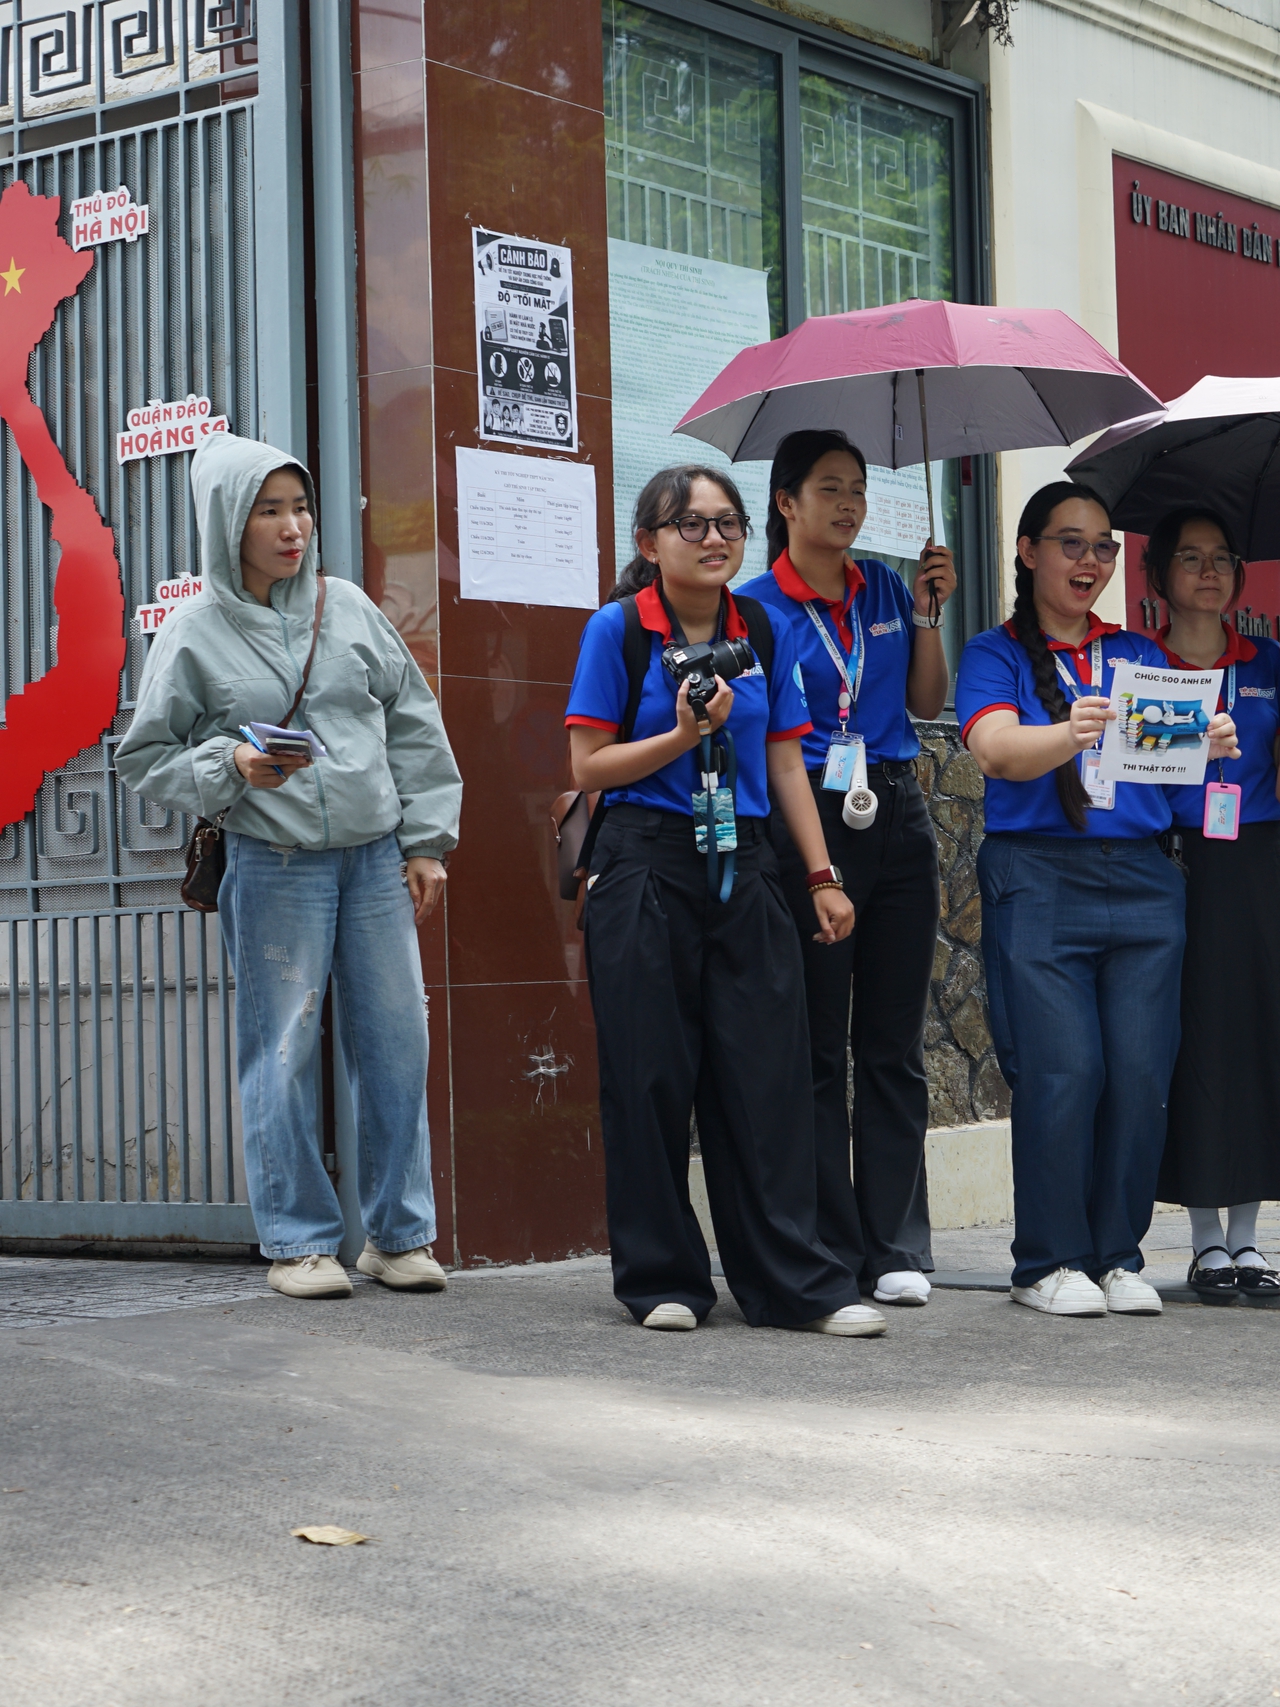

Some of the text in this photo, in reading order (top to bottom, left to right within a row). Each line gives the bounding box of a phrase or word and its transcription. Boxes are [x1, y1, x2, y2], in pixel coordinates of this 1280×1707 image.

[74, 191, 126, 217] THỦ ĐÔ
[76, 208, 146, 246] HÀ NỘI
[1130, 180, 1152, 226] ỦY
[1157, 200, 1190, 238] BAN
[1194, 211, 1238, 253] NHÂN
[1242, 222, 1272, 264] DÂN
[500, 246, 546, 268] CẢNH BÁO
[666, 260, 678, 271] QUY
[498, 290, 510, 305] ĐỘ
[131, 398, 208, 426] QUẦN ĐẢO
[120, 425, 194, 458] HOÀNG
[160, 577, 202, 600] QUẦN
[1141, 597, 1161, 630] 11
[1134, 672, 1160, 682] CHÚC
[1162, 675, 1180, 684] 500
[1122, 763, 1137, 771] THI
[1138, 764, 1160, 774] THẬT
[1161, 764, 1176, 773] TỐT
